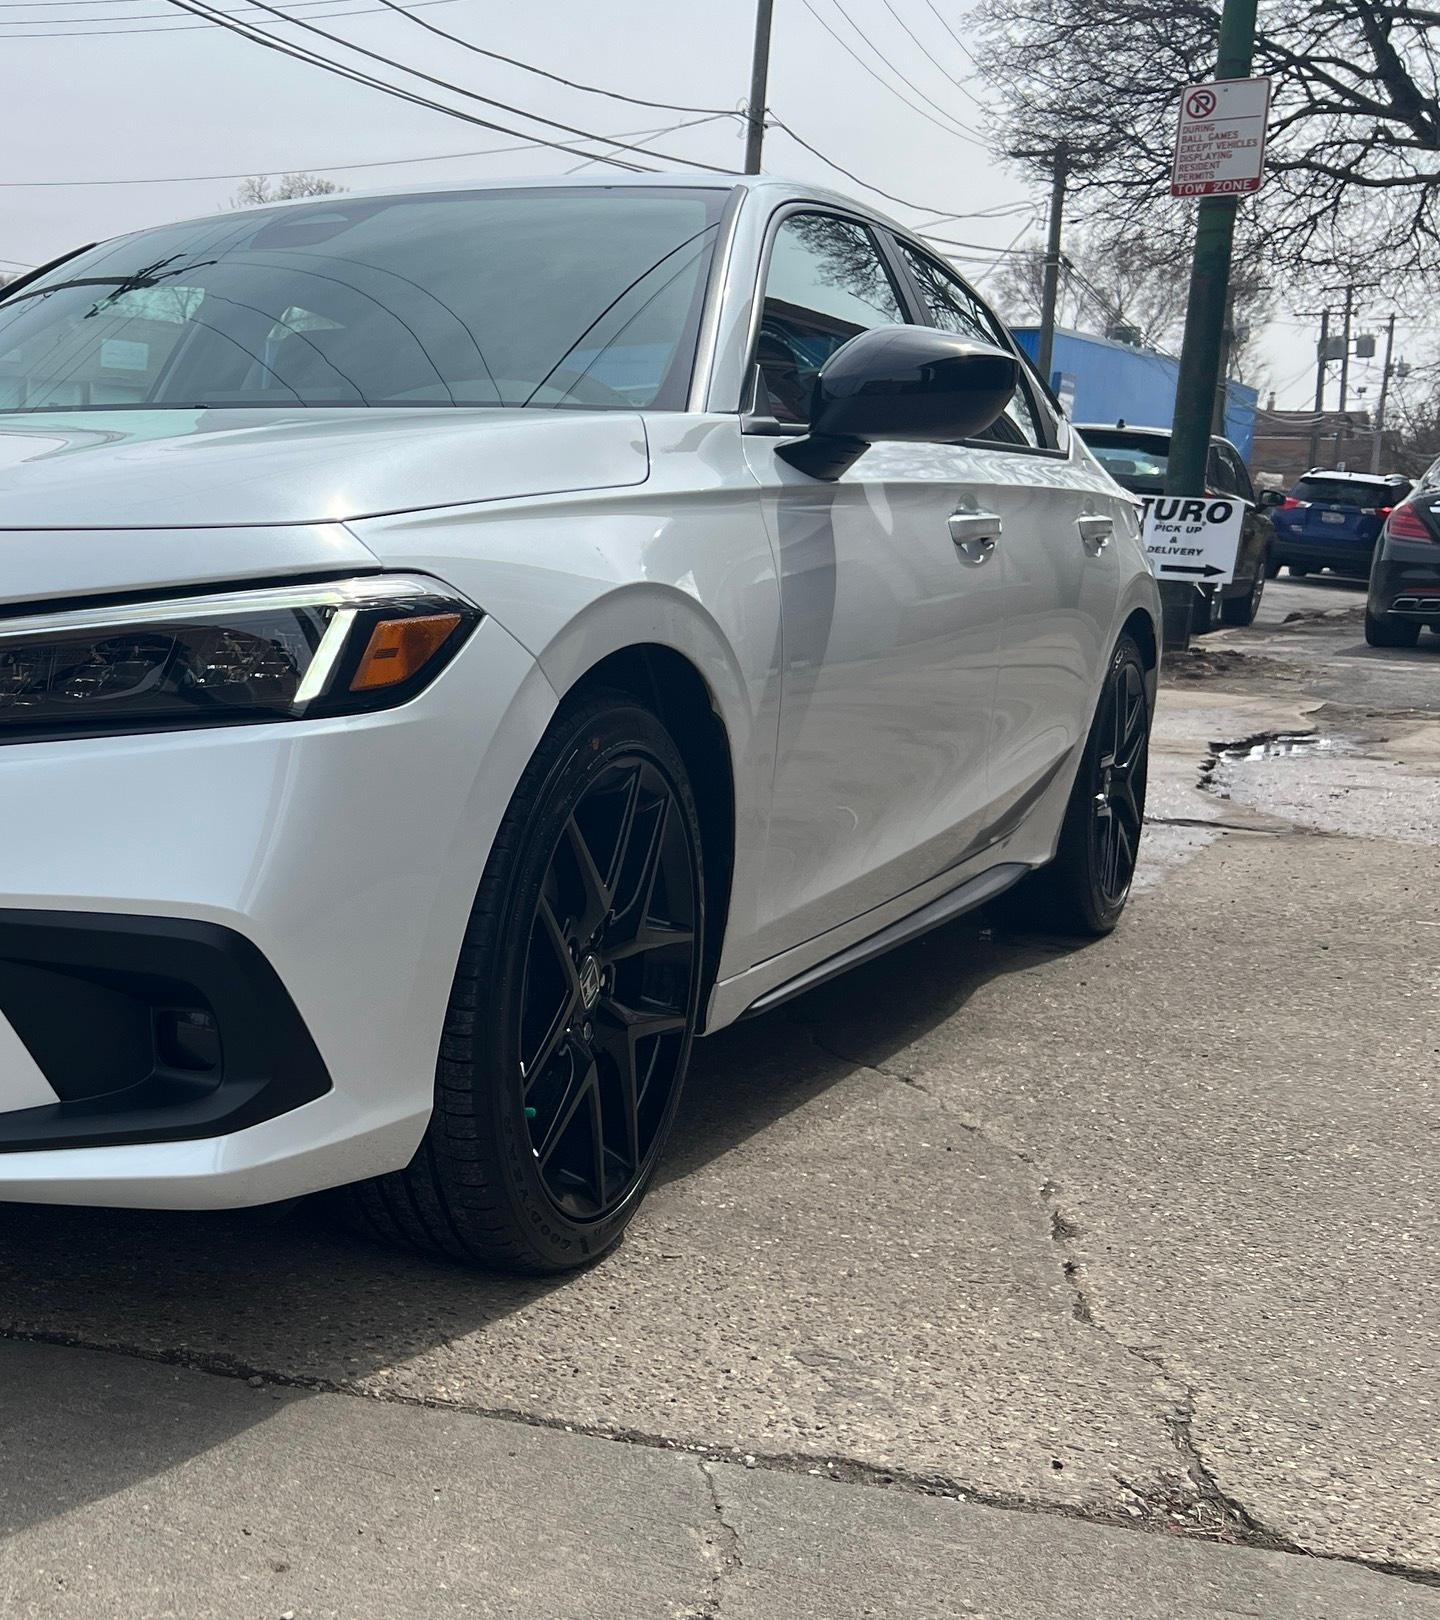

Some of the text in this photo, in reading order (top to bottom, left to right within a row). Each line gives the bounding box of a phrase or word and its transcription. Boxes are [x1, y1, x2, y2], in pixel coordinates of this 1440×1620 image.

[1182, 124, 1215, 134] DURING
[1181, 130, 1239, 143] BALL GAMES
[1180, 139, 1258, 153] EXCEPT VEHICLES
[1180, 151, 1232, 162] DISPLAYING
[1178, 161, 1221, 172] RESIDENT
[1178, 171, 1215, 182] PERMITS
[1177, 179, 1253, 195] TOW ZONE
[1141, 497, 1233, 524] TURO
[1154, 524, 1202, 534] PICK UP
[1146, 546, 1204, 556] DELIVERY
